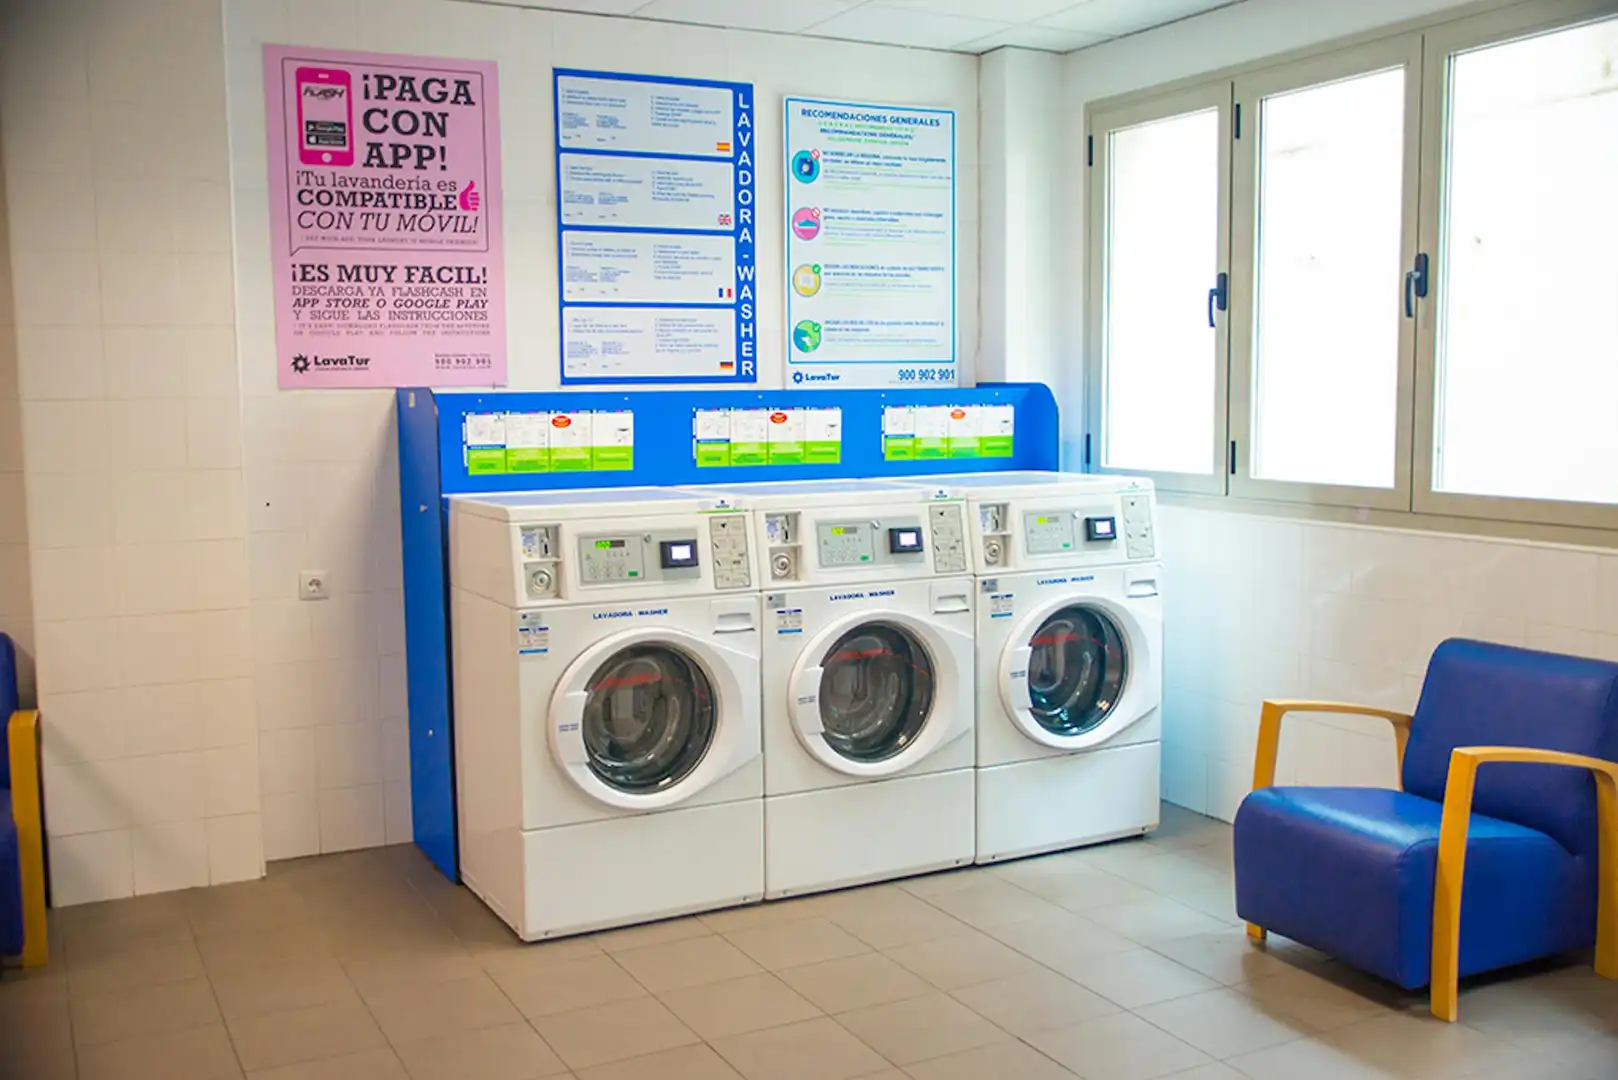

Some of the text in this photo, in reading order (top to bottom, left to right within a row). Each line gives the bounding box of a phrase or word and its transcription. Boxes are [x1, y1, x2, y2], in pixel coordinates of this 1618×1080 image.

[362, 74, 476, 106] ¡PAGA
[363, 108, 449, 138] CON
[801, 109, 940, 127] RECOMENDACIONES GENERALES
[362, 142, 448, 170] APP!
[737, 92, 752, 243] LAVADORA
[296, 170, 457, 191] ¡Tu lavandería es
[296, 190, 457, 211] COMPATIBLE
[297, 207, 479, 234] CON TU MÓVIL!
[292, 264, 488, 284] ¡ES MUY FACIL!
[292, 286, 486, 298] DESCARGA YA FLASHCASH EN
[292, 299, 489, 309] APP STORE O GOOGLE PLAY
[292, 310, 488, 321] Y SIGUE LAS INSTRUCCIONES
[737, 266, 754, 376] WASHER
[314, 355, 370, 366] LavaTur
[898, 369, 955, 380] 900 902 901
[593, 608, 668, 620] LAVADORA WASHER
